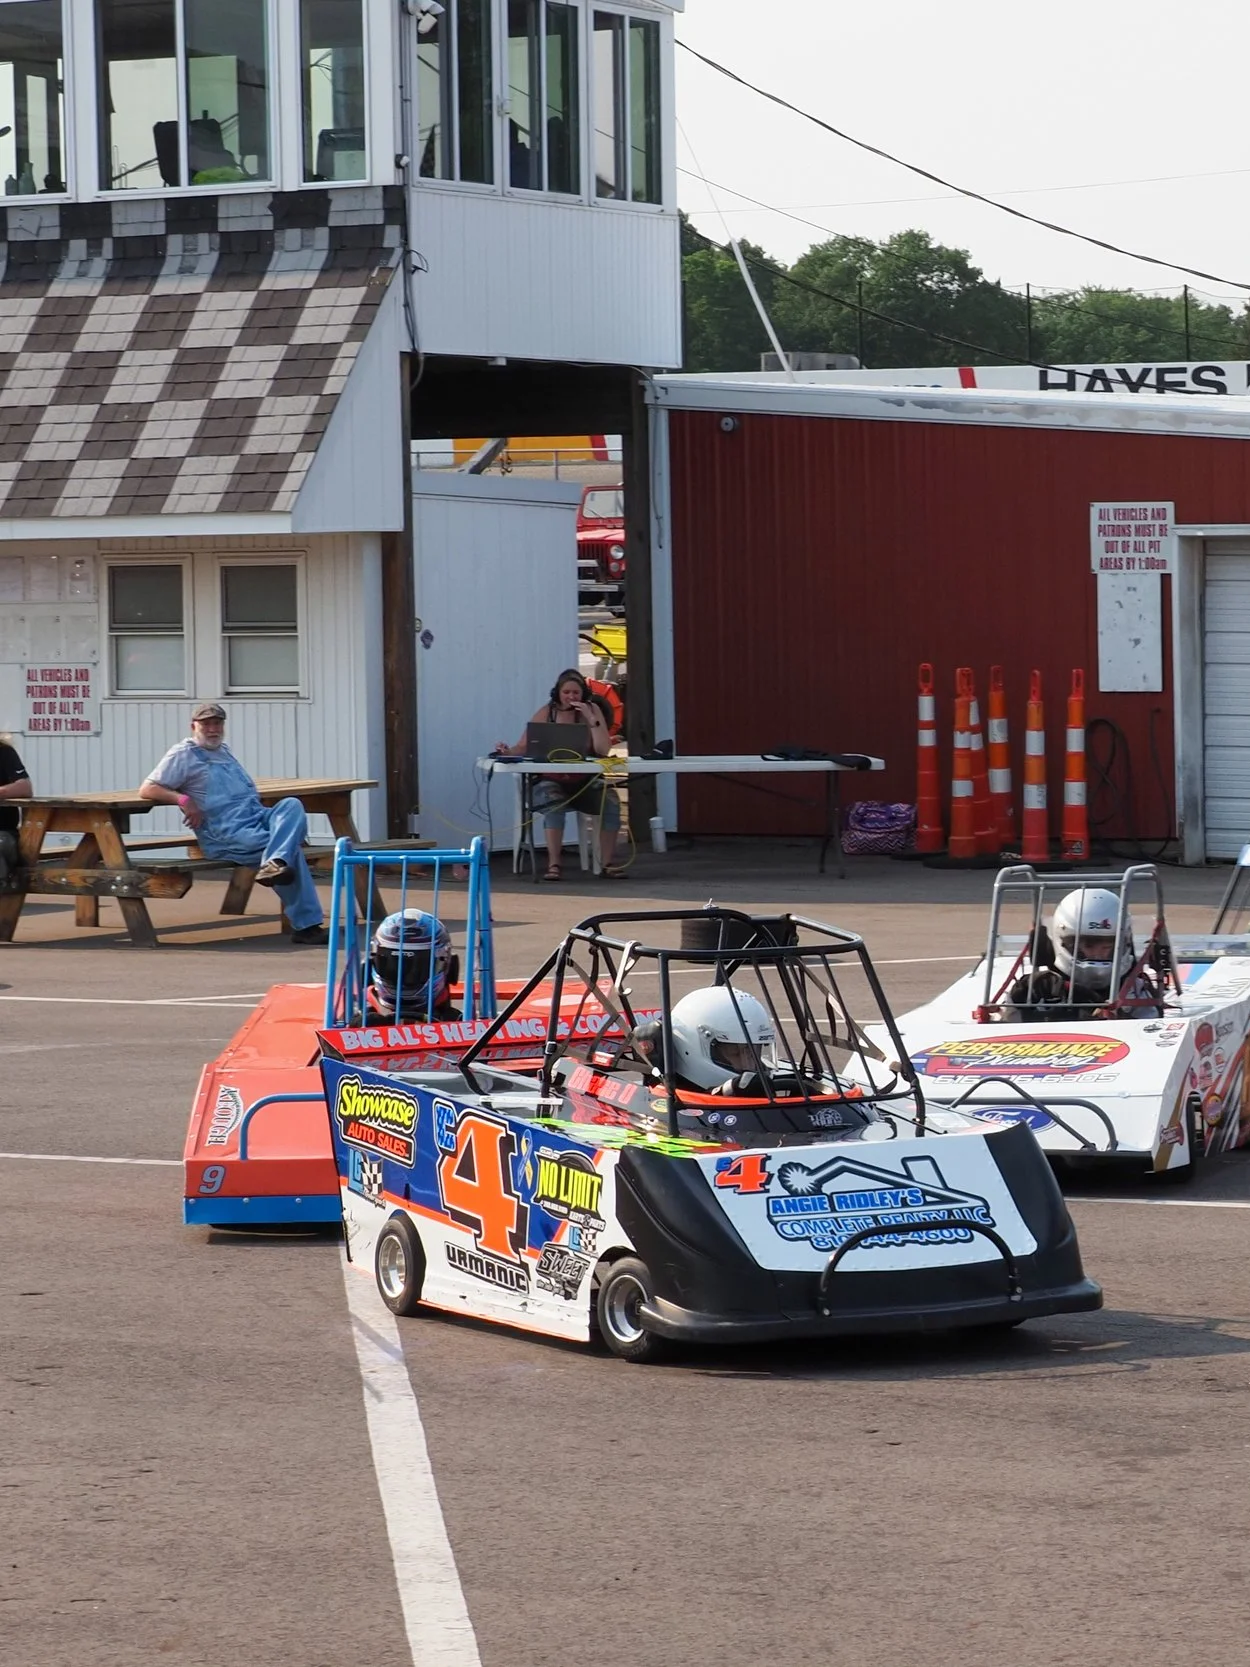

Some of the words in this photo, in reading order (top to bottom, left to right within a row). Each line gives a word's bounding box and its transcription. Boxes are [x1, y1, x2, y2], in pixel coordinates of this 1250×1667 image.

[1039, 365, 1228, 395] HAYES
[1099, 507, 1110, 521] ALL
[1113, 507, 1148, 521] VEHICLES
[1151, 507, 1167, 521] AND
[1098, 524, 1131, 537] PATRONS
[1134, 524, 1156, 537] MUST
[1159, 524, 1168, 537] BE
[1104, 541, 1118, 553] OUT
[1121, 541, 1130, 553] OF
[1133, 541, 1145, 553] ALL
[1148, 541, 1161, 553] PIT
[1099, 557, 1123, 570] AREAS
[1126, 557, 1135, 570] BY
[1139, 557, 1167, 570] 1:00am
[27, 668, 38, 681] ALL
[41, 668, 72, 681] VEHICLES
[75, 668, 89, 681] AND
[26, 685, 57, 698] PATRONS
[60, 685, 80, 698] MUST
[82, 685, 90, 698] BE
[33, 702, 46, 715] OUT
[48, 702, 56, 715] OF
[59, 702, 70, 715] ALL
[73, 702, 84, 715] PIT
[28, 718, 50, 731] AREAS
[53, 718, 62, 731] BY
[65, 718, 90, 731] 1:00am
[340, 1029, 381, 1050] BIG
[388, 1024, 439, 1048] AL'S
[932, 1041, 1120, 1057] PERFORMANCE
[340, 1084, 415, 1126] Showcase
[347, 1121, 376, 1144] AUTO
[377, 1132, 408, 1157] SALES
[199, 1164, 227, 1195] 9
[537, 1159, 559, 1199] NO
[558, 1164, 602, 1213] LIMIT
[771, 1196, 830, 1216] ANGIE
[836, 1188, 923, 1211] RIDLEY'S
[777, 1215, 874, 1238] COMPLETE
[541, 1248, 590, 1281] SWEET
